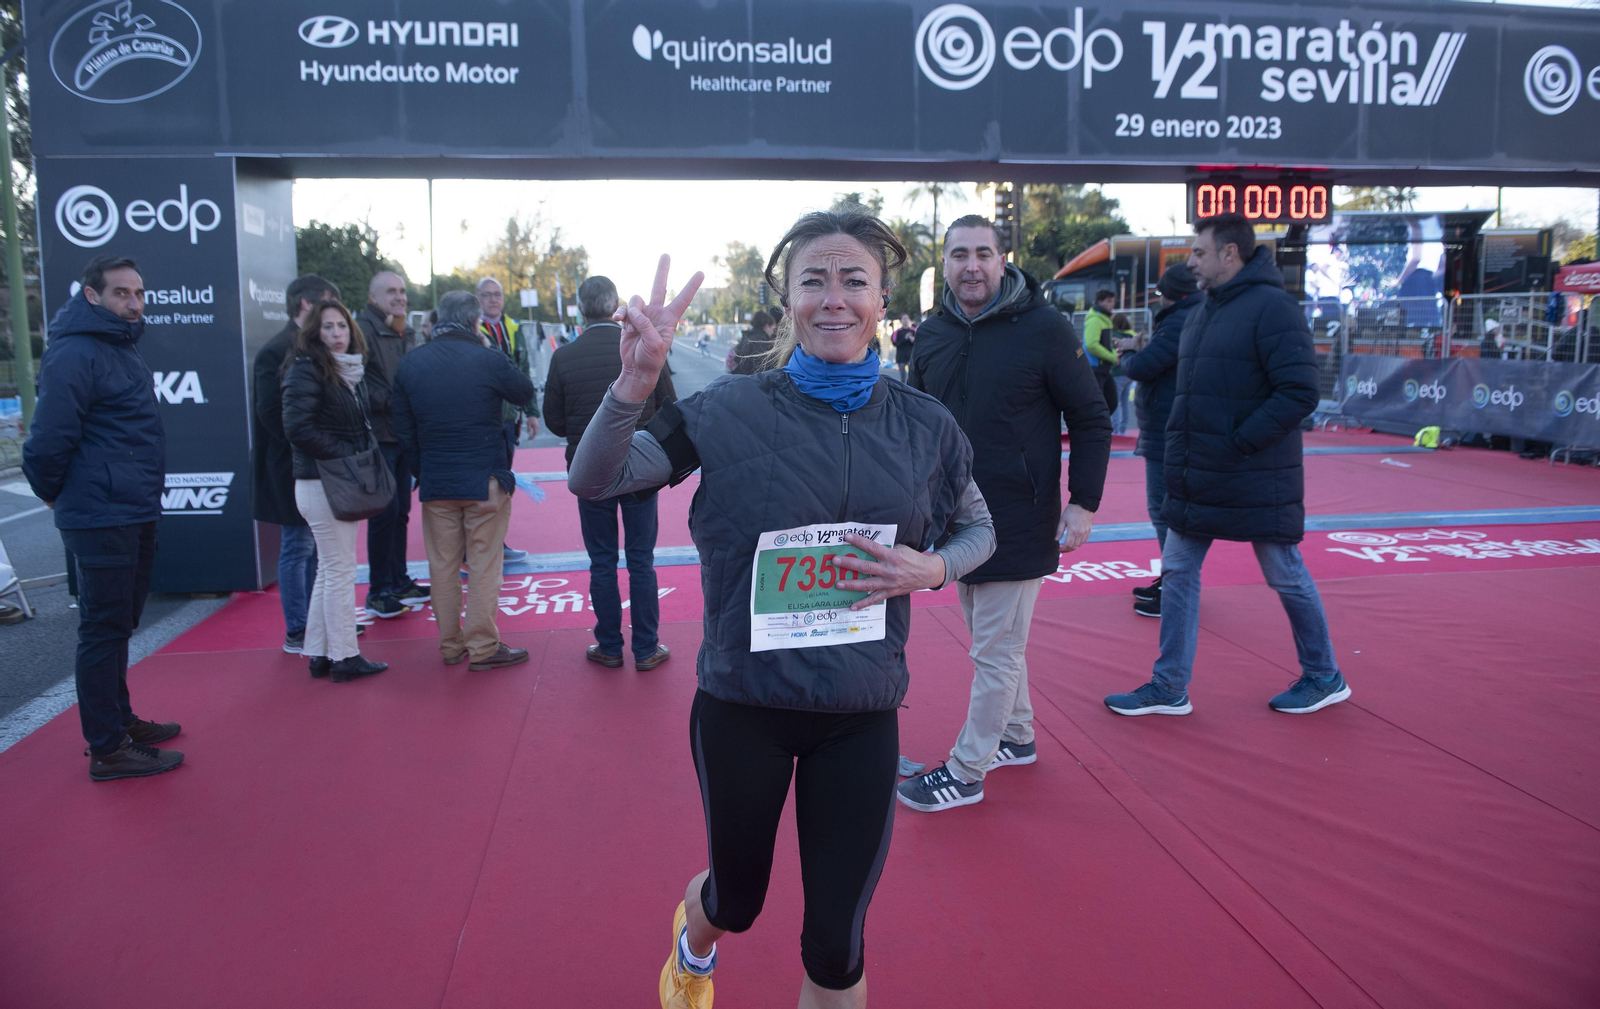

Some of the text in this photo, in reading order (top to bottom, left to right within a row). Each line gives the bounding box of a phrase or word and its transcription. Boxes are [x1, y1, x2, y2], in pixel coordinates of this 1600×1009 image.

[367, 20, 519, 47] HYUNDAI
[84, 38, 175, 76] Plátano de Canarias
[662, 37, 832, 69] quirónsalud
[1003, 6, 1124, 89] edp
[1205, 19, 1418, 66] maratón
[299, 60, 519, 88] Hyundauto Motor
[690, 74, 832, 94] Healthcare Partner
[1260, 58, 1418, 105] sevilla
[1115, 113, 1282, 139] 29 enero 2023
[125, 183, 222, 244] edp
[144, 285, 214, 304] nsalud
[173, 312, 214, 325] Partner
[153, 371, 204, 404] KA
[1357, 376, 1378, 400] edp
[1419, 379, 1447, 404] edp
[1490, 384, 1524, 412] edp
[182, 476, 225, 484] NACIONAL
[161, 487, 229, 510] NING
[789, 530, 813, 545] edp
[500, 575, 569, 593] dp
[1043, 567, 1152, 583] villa
[833, 599, 854, 607] LUNA
[816, 610, 838, 622] edp
